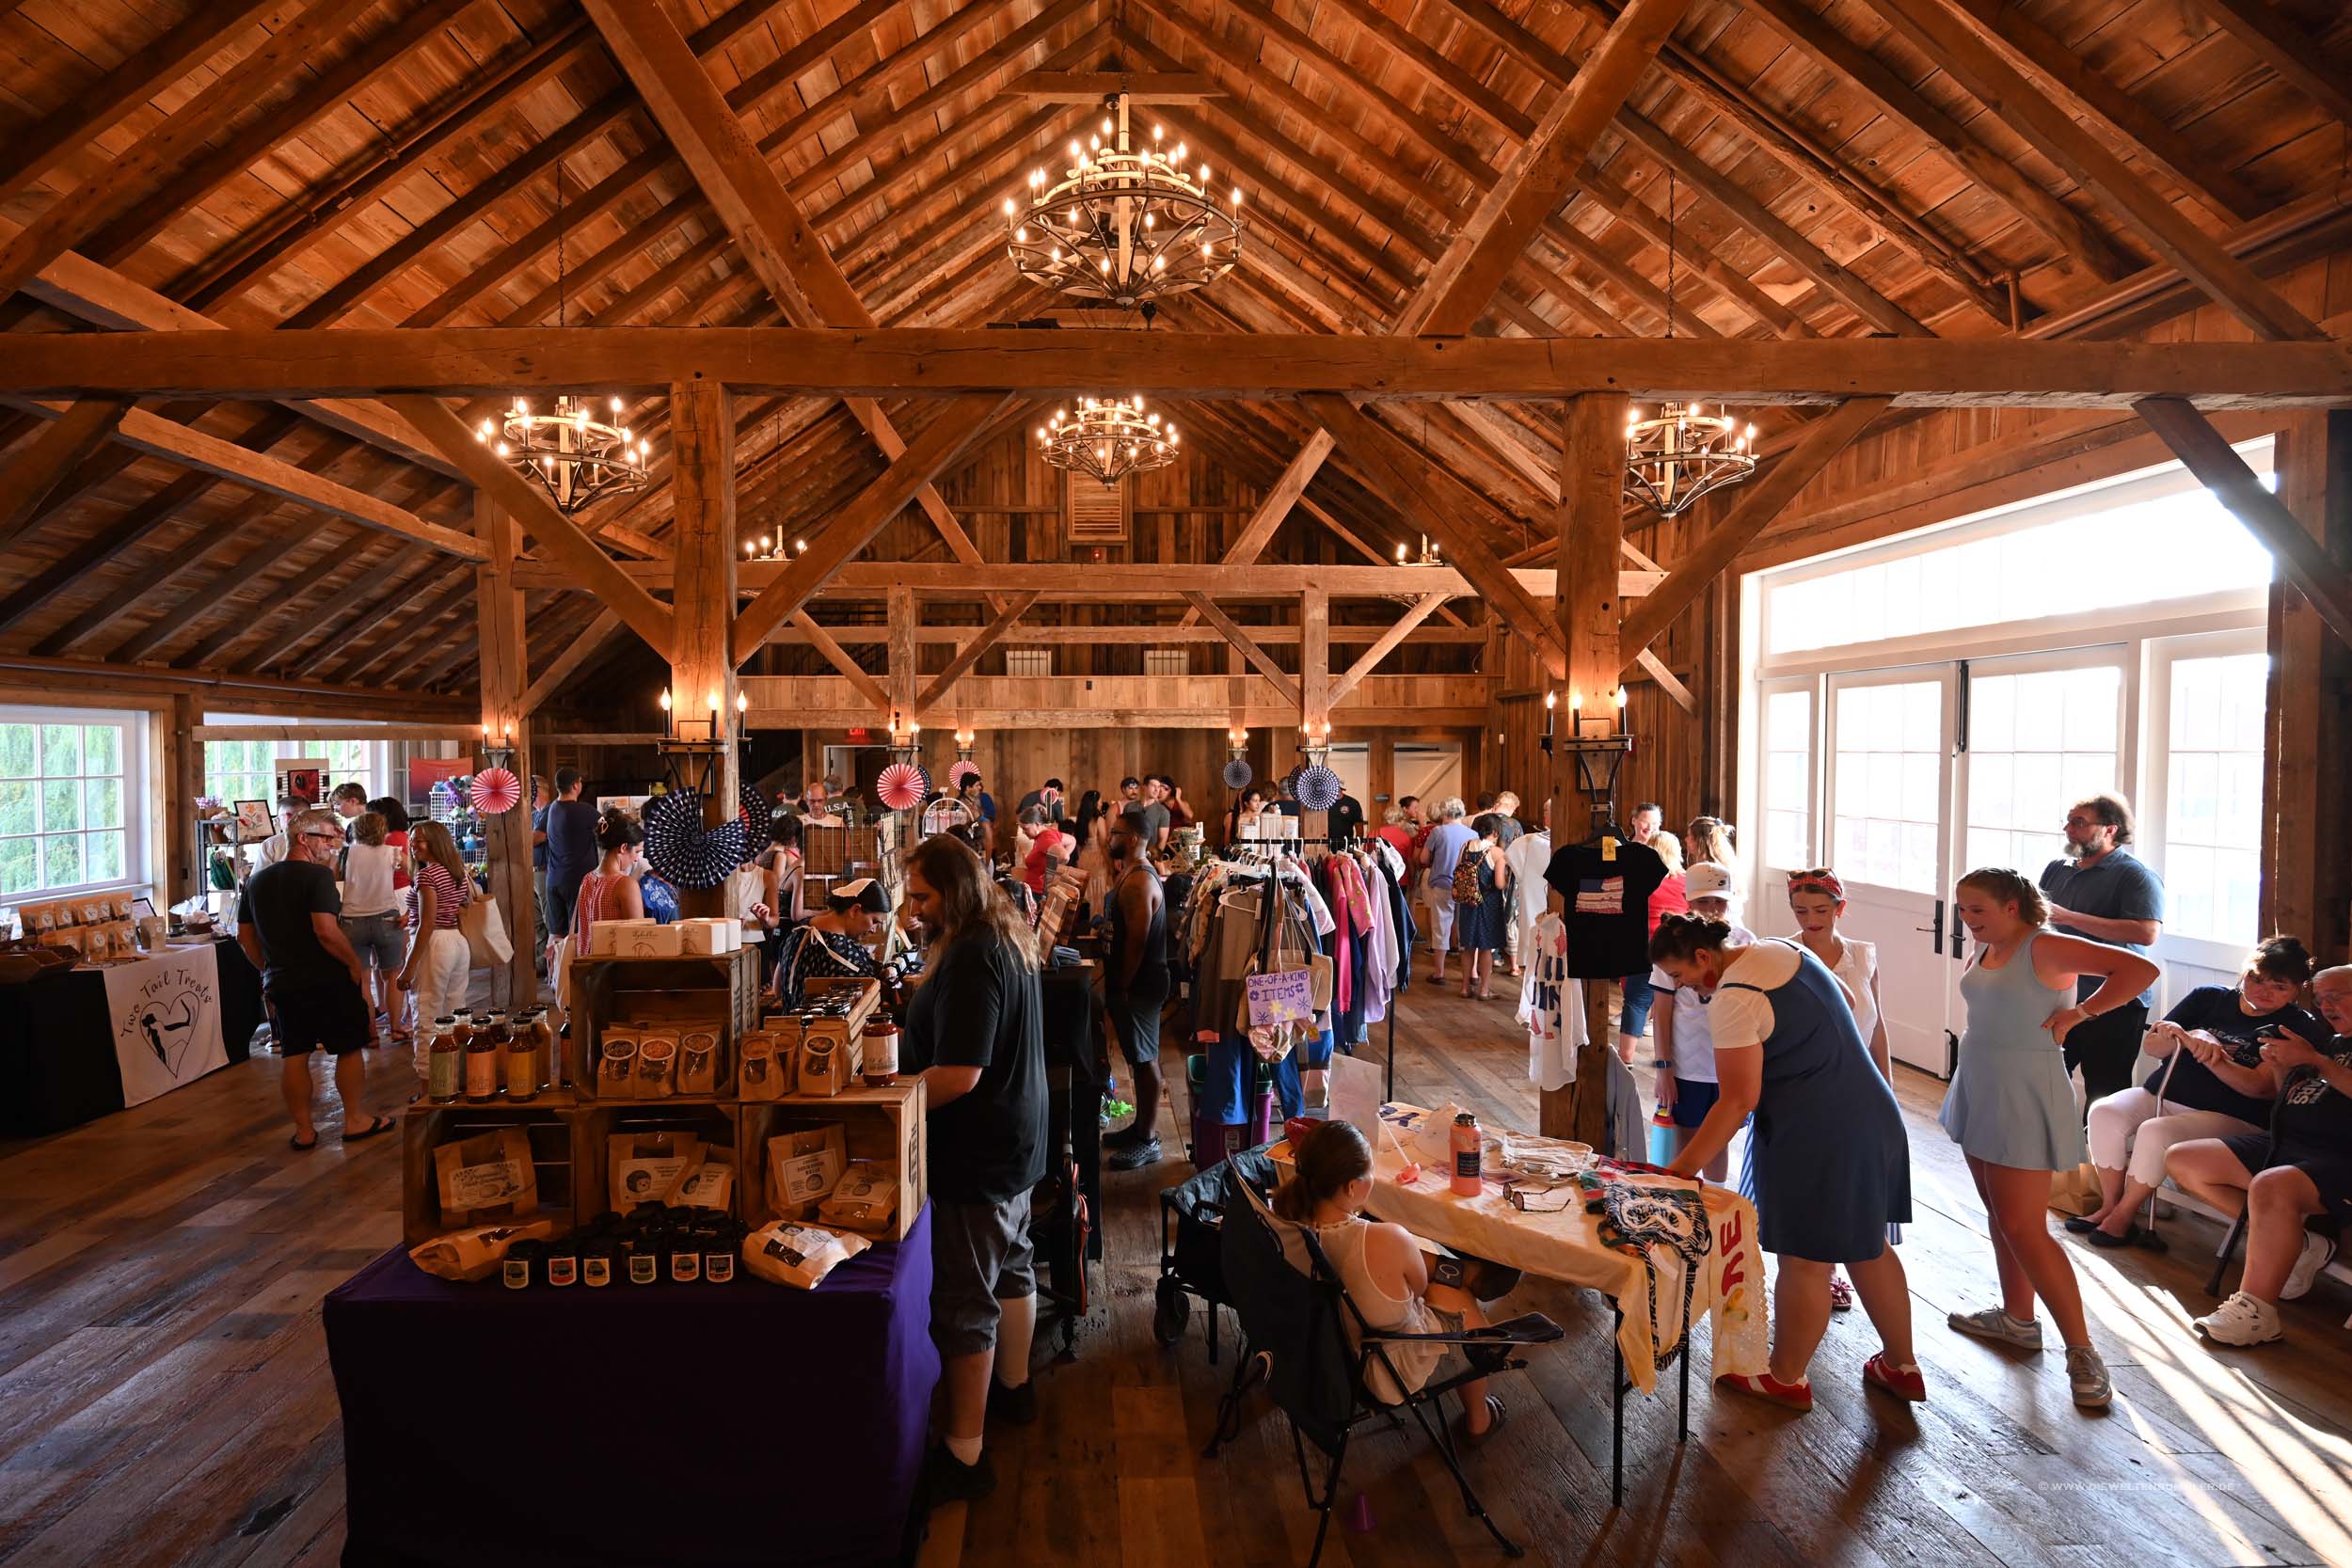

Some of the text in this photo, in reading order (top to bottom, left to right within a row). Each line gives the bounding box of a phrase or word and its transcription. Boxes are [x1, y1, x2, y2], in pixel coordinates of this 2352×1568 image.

[1248, 972, 1308, 987] ONE-OF-A-KIND
[1262, 985, 1295, 1002] ITEMS
[120, 969, 212, 1037] Two Tail Treats
